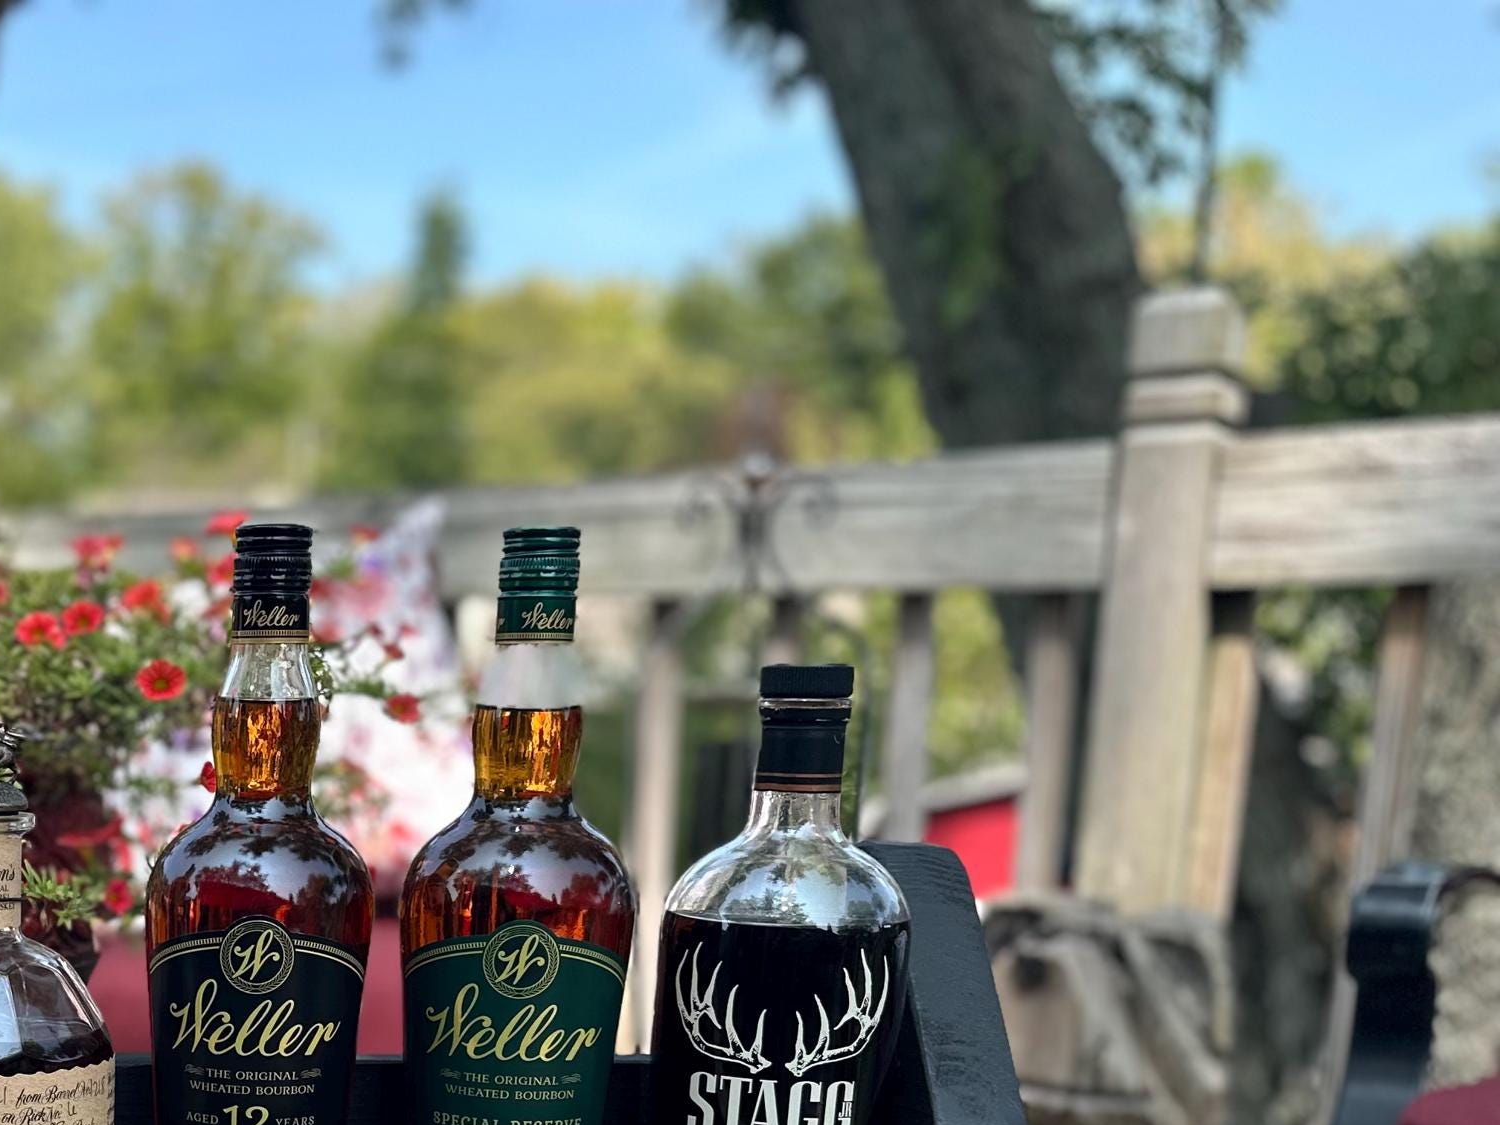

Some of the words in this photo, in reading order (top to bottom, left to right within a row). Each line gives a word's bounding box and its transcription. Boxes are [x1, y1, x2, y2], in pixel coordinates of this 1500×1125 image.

[244, 600, 300, 627] Weller
[522, 602, 573, 629] Weller
[169, 979, 341, 1057] Weller
[425, 983, 602, 1062] Weller
[206, 1068, 231, 1079] THE
[235, 1071, 299, 1081] ORIGINAL
[463, 1072, 490, 1083] THE
[494, 1075, 559, 1086] ORIGINAL
[16, 1088, 41, 1108] from
[41, 1083, 79, 1104] Barrel
[189, 1079, 250, 1095] WHEATED
[255, 1084, 315, 1096] BOURBON
[445, 1083, 510, 1099] WHEATED
[515, 1089, 575, 1101] BOURBON
[1, 1112, 16, 1124] on
[15, 1107, 46, 1125] Rick
[186, 1111, 219, 1125] AGED
